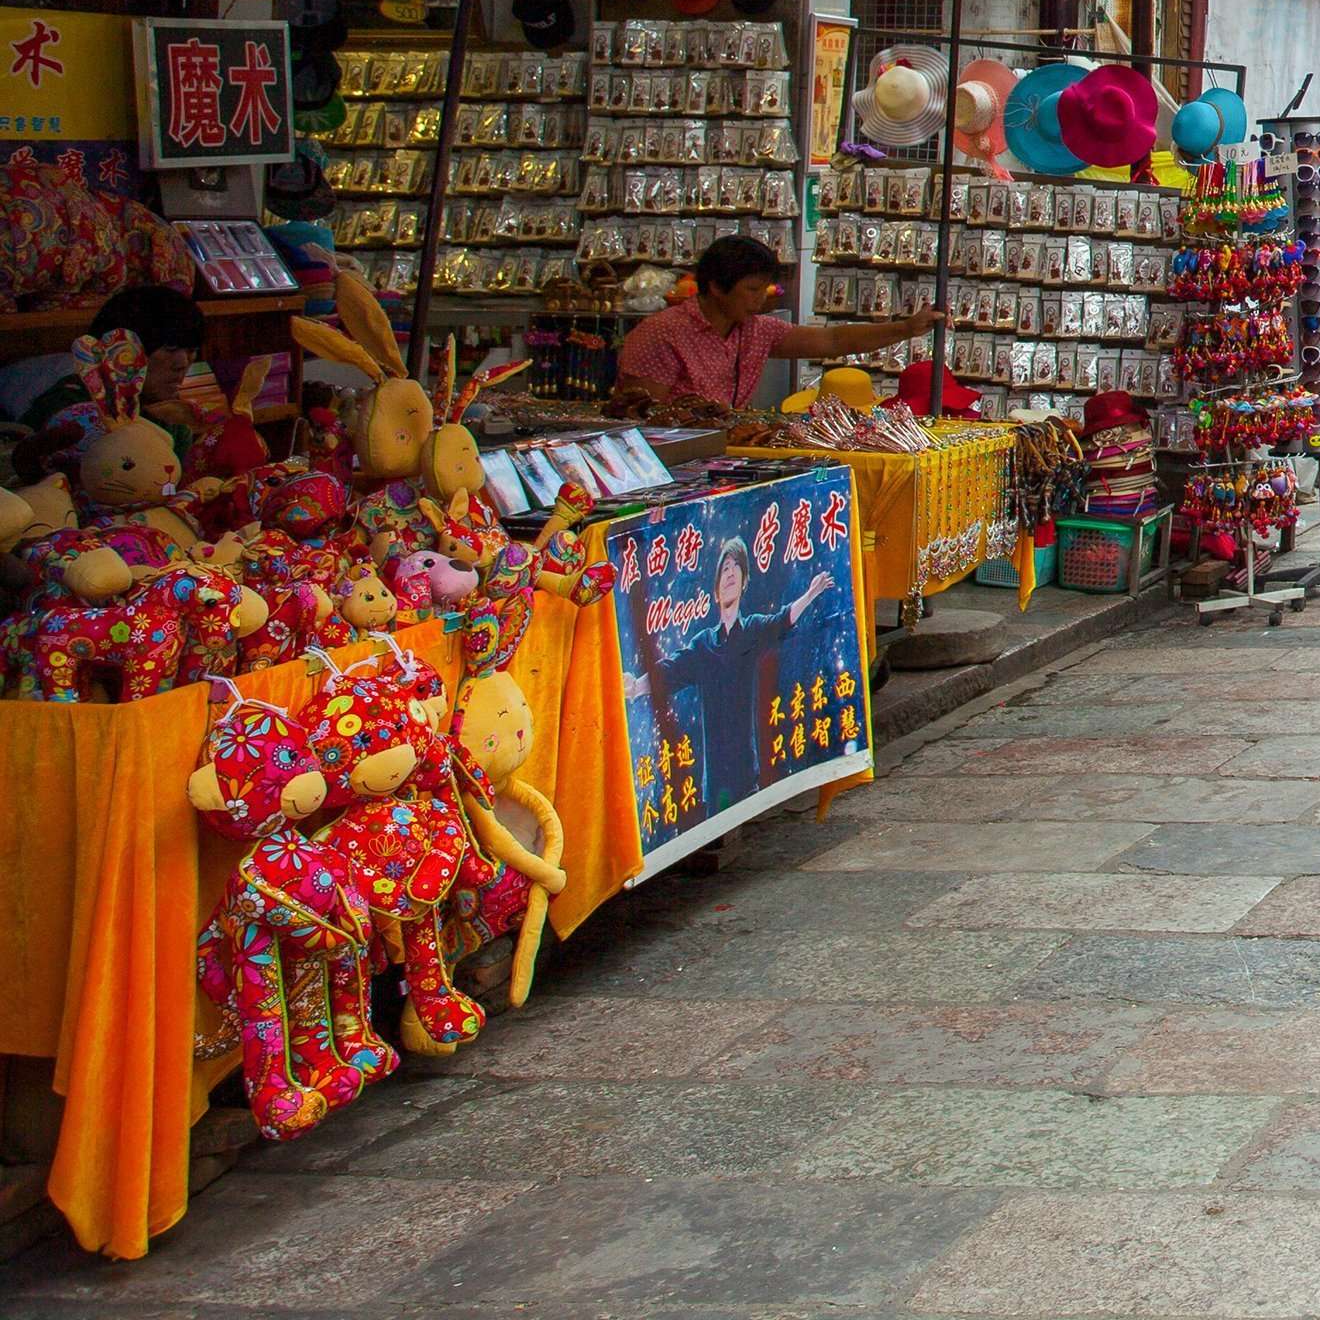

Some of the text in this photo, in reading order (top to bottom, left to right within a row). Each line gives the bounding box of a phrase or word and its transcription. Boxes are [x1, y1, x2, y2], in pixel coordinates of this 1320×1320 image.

[167, 37, 283, 148] 魔术
[619, 489, 850, 595] 在西街 学魔术
[646, 589, 712, 637] Magic
[768, 670, 858, 728] 不卖东西
[769, 707, 862, 769] 只售智慧
